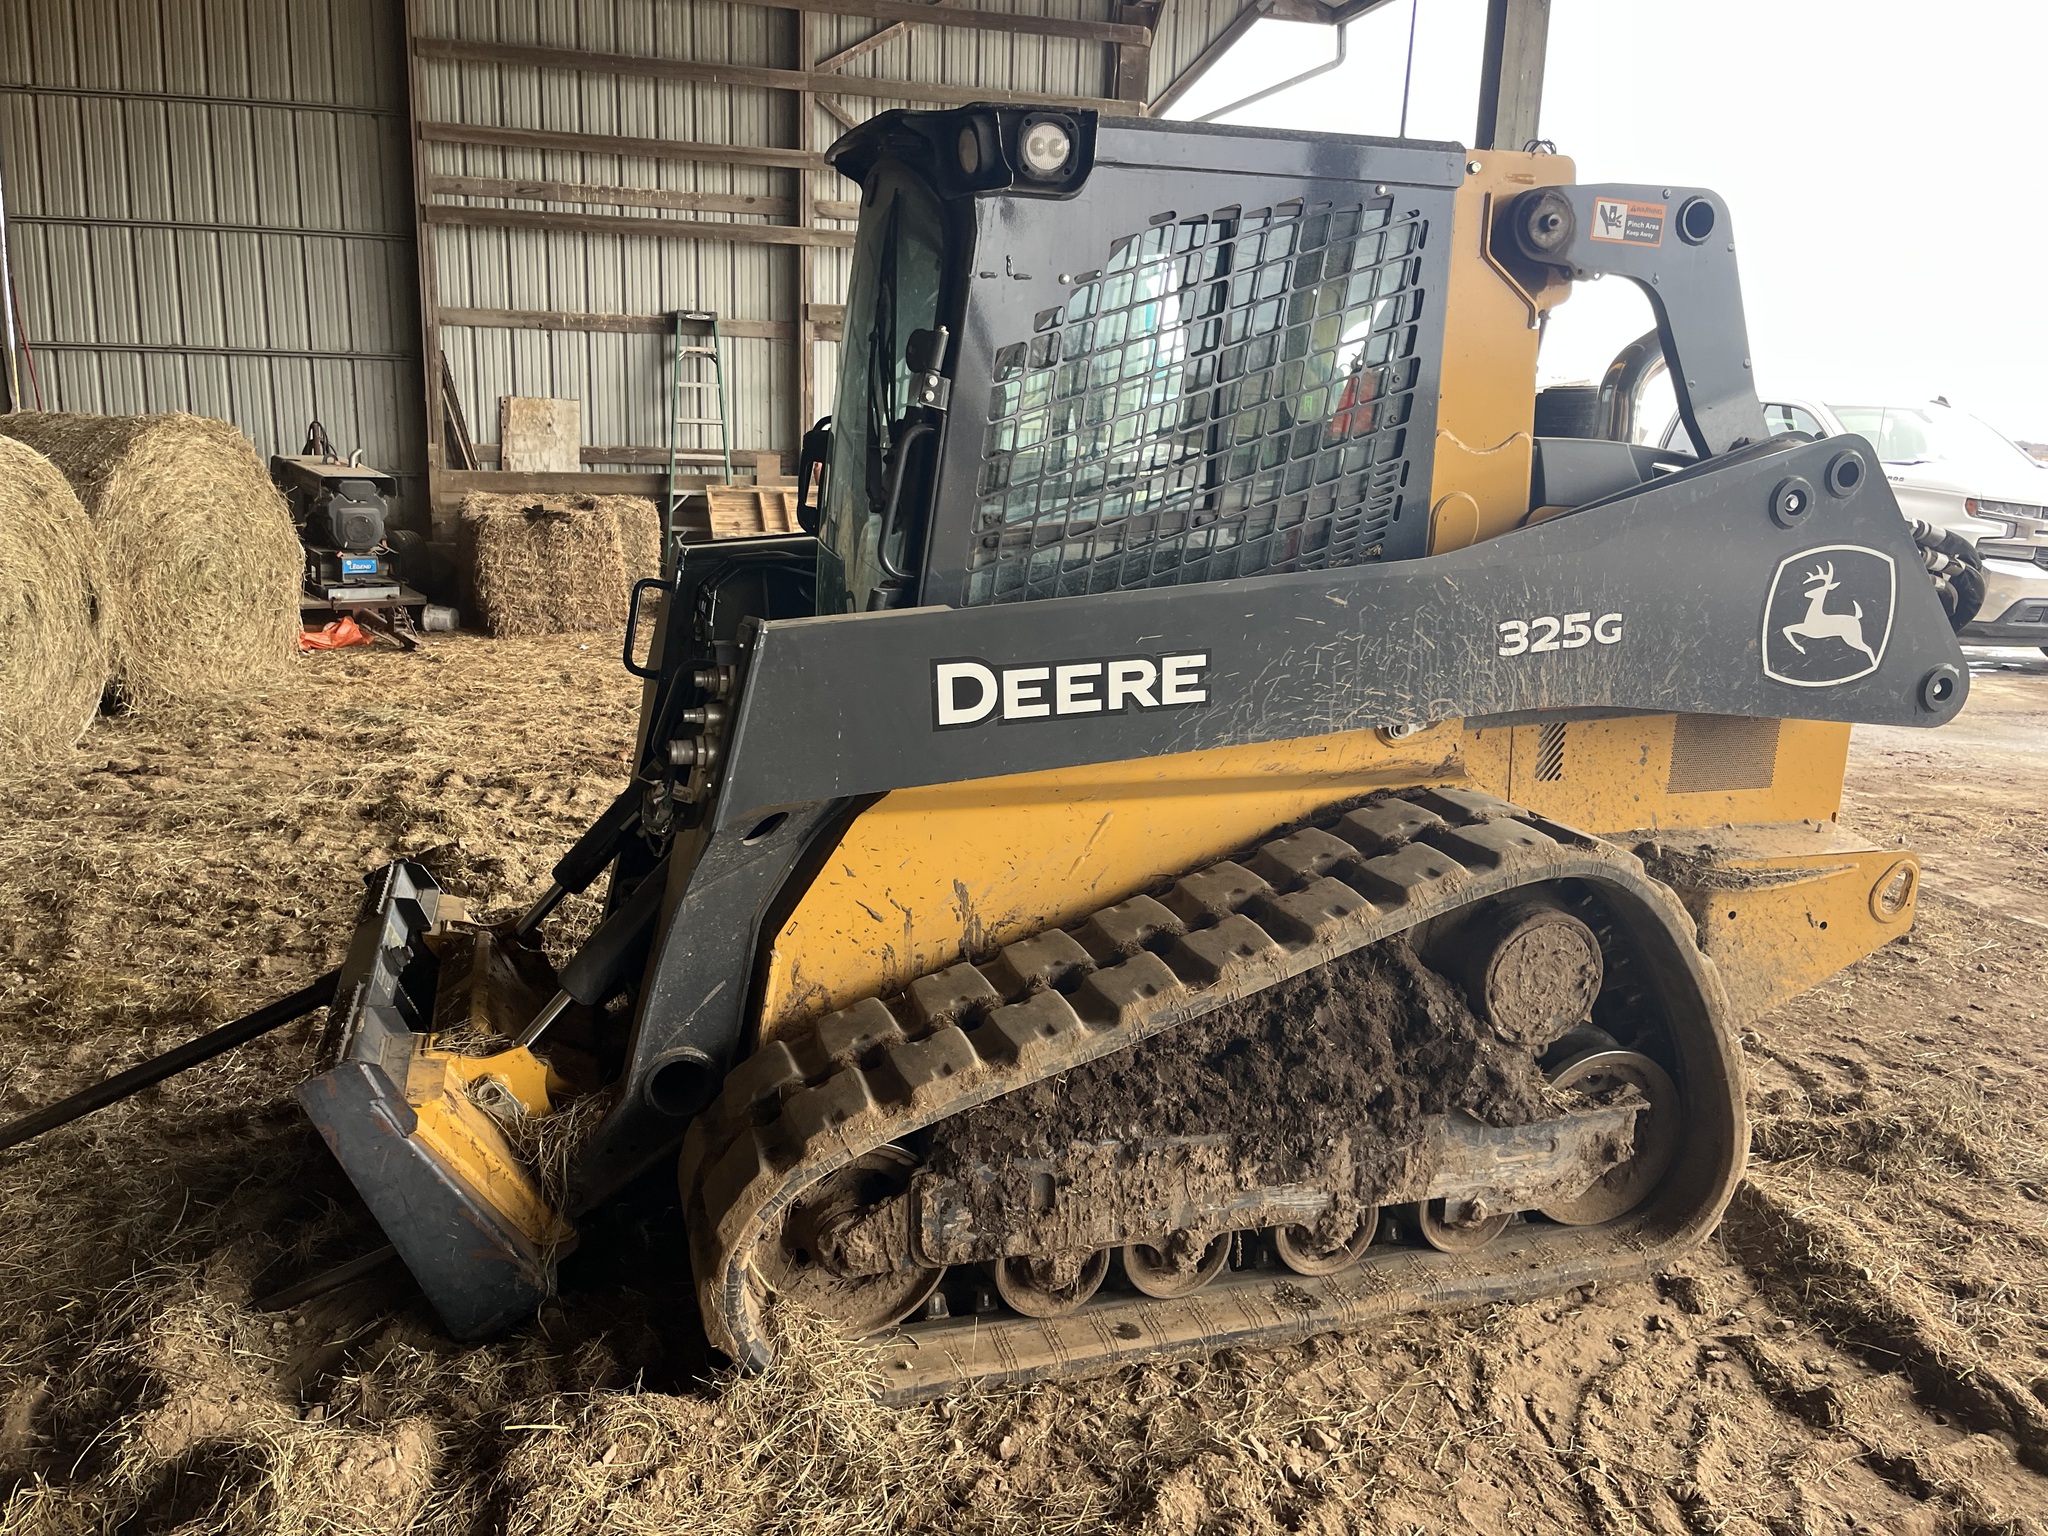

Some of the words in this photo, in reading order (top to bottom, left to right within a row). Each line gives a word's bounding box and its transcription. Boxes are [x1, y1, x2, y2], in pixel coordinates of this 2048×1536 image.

[1636, 206, 1663, 215] WARNING
[1627, 220, 1644, 229] Pinch
[1645, 222, 1660, 231] Area
[1626, 229, 1639, 237] Keep
[1640, 231, 1654, 239] Away
[1498, 612, 1623, 656] 325G
[936, 654, 1207, 725] DEERE
